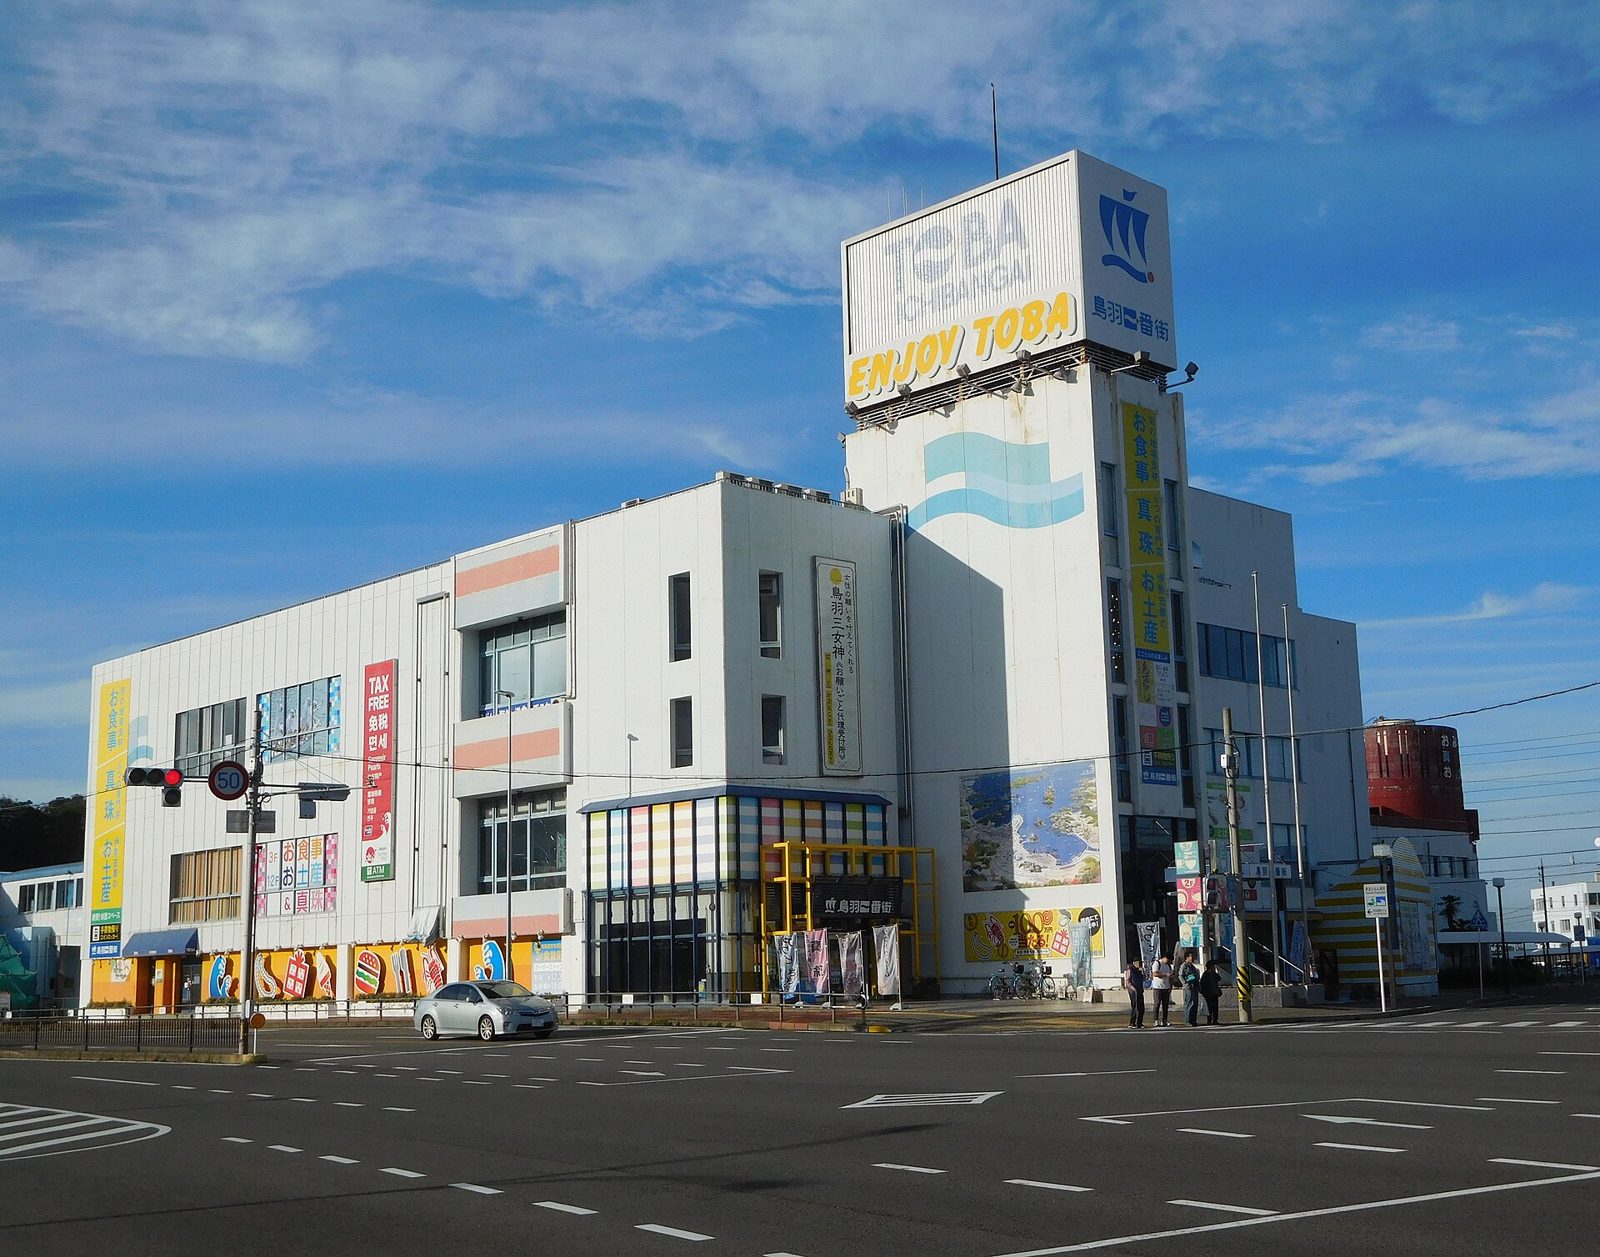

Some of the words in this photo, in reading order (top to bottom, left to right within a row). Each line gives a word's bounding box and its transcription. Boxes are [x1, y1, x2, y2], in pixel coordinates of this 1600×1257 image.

[884, 199, 1029, 295] TOBA
[848, 323, 962, 399] ENJOY
[973, 291, 1075, 360] TOBA
[1133, 410, 1149, 483] お食事
[1137, 497, 1154, 556] 真珠
[1141, 568, 1160, 645] お土産
[831, 585, 845, 660] 鳥羽三女神
[368, 674, 389, 693] TAX
[368, 694, 389, 711] FREE
[108, 688, 118, 752] お食事
[368, 733, 388, 751] 면세
[104, 768, 114, 820] 真珠
[217, 772, 240, 790] 50
[269, 851, 278, 864] 3F
[283, 837, 324, 863] お食事
[101, 838, 112, 903] お土産
[282, 861, 324, 887] お土産
[373, 865, 385, 875] ATM
[1184, 879, 1194, 887] 2F
[296, 889, 324, 914] 真珠
[1012, 913, 1044, 937] 100
[1187, 915, 1196, 923] 1F
[1018, 934, 1050, 949] 当たる!
